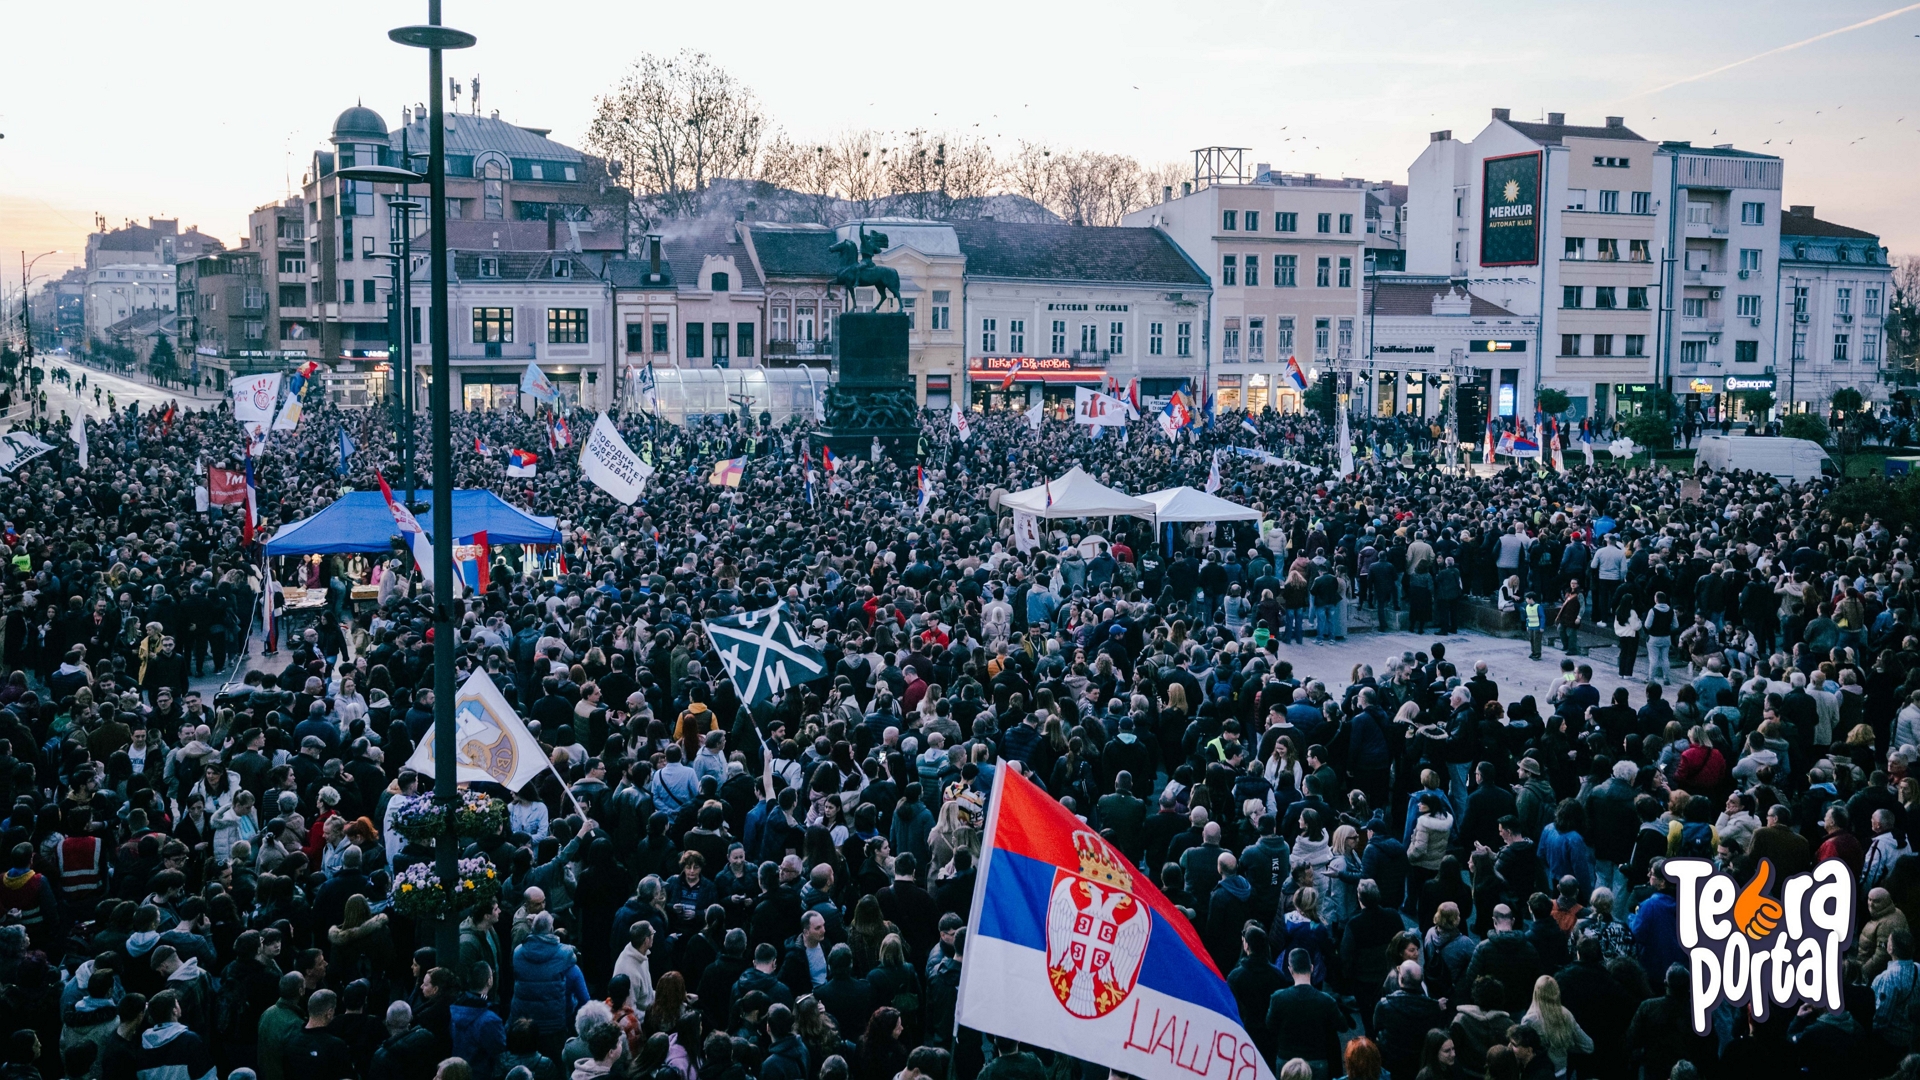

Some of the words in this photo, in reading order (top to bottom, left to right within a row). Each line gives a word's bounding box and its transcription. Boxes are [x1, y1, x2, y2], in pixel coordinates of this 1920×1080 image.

[1489, 204, 1533, 218] MERKUR
[1489, 220, 1516, 228] AUTOMAT
[1380, 345, 1414, 353] Raiffeisen
[1415, 345, 1435, 353] BANK
[596, 428, 634, 467] СЛОБОДНИ
